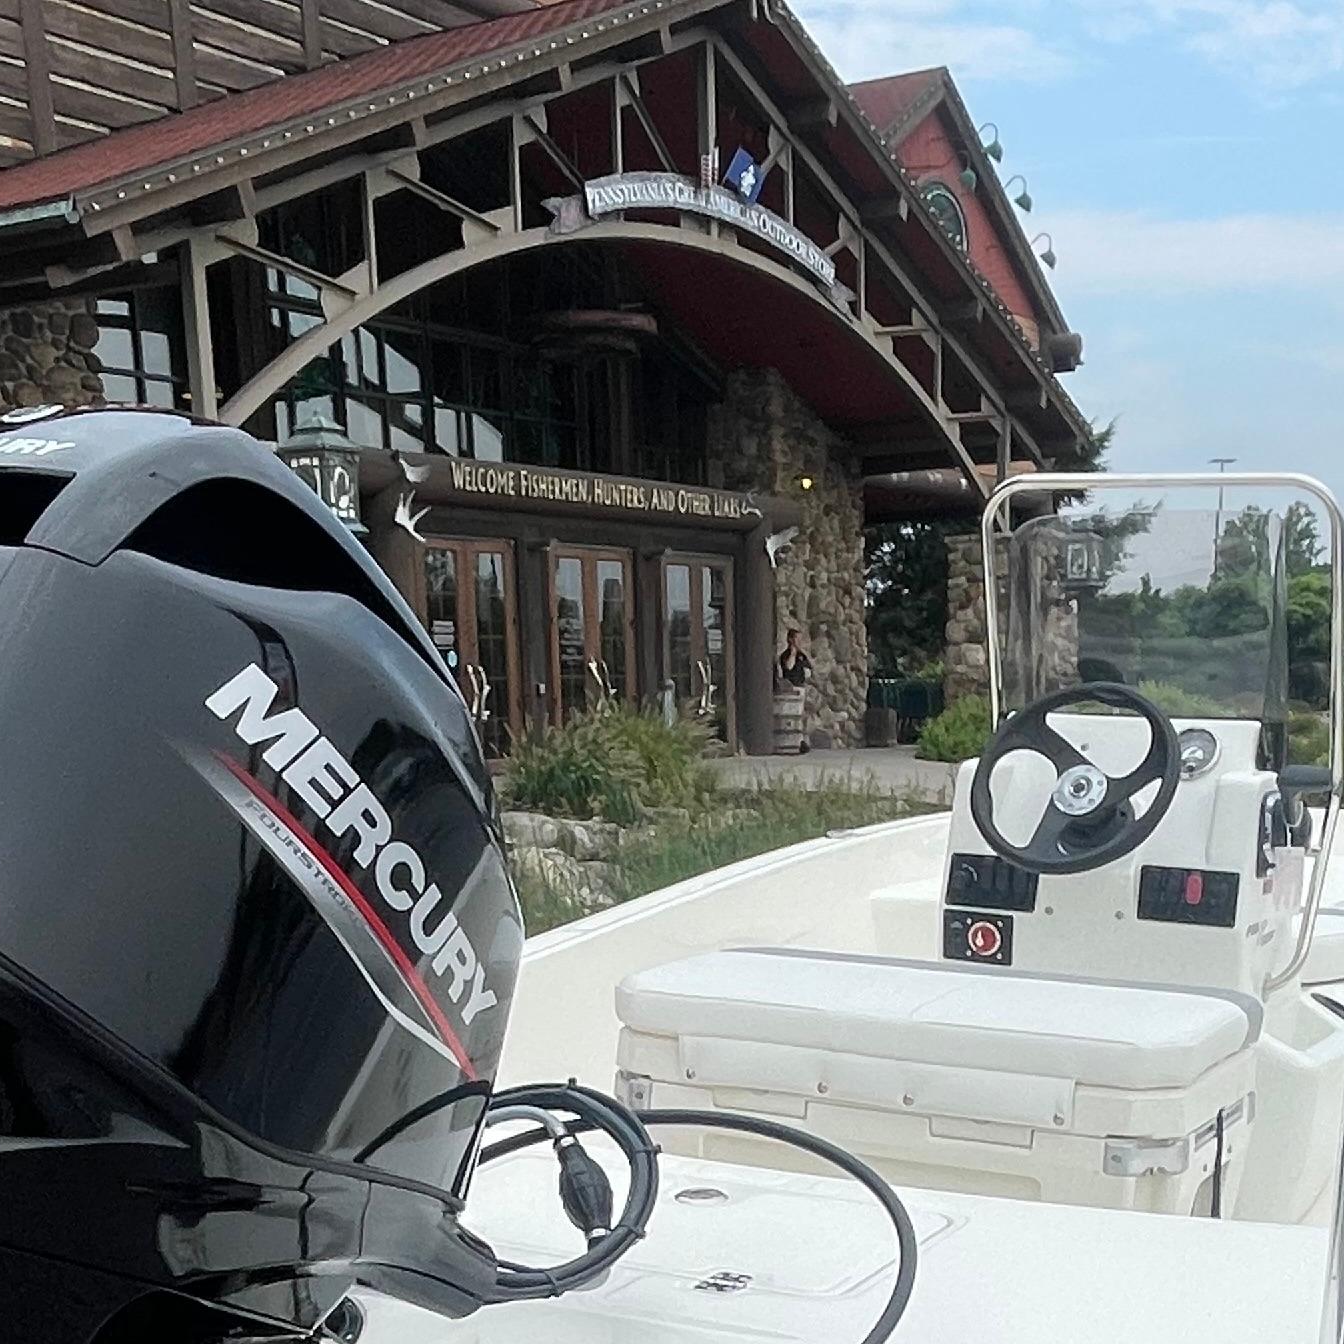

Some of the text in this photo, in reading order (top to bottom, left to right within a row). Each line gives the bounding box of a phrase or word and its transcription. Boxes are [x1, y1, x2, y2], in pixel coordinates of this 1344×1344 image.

[759, 213, 808, 260] OUTDOOR
[451, 461, 741, 519] WELCOME FISHERMEN, HUNTERS, AND OTHER LIARS
[205, 663, 497, 1025] MERCURY
